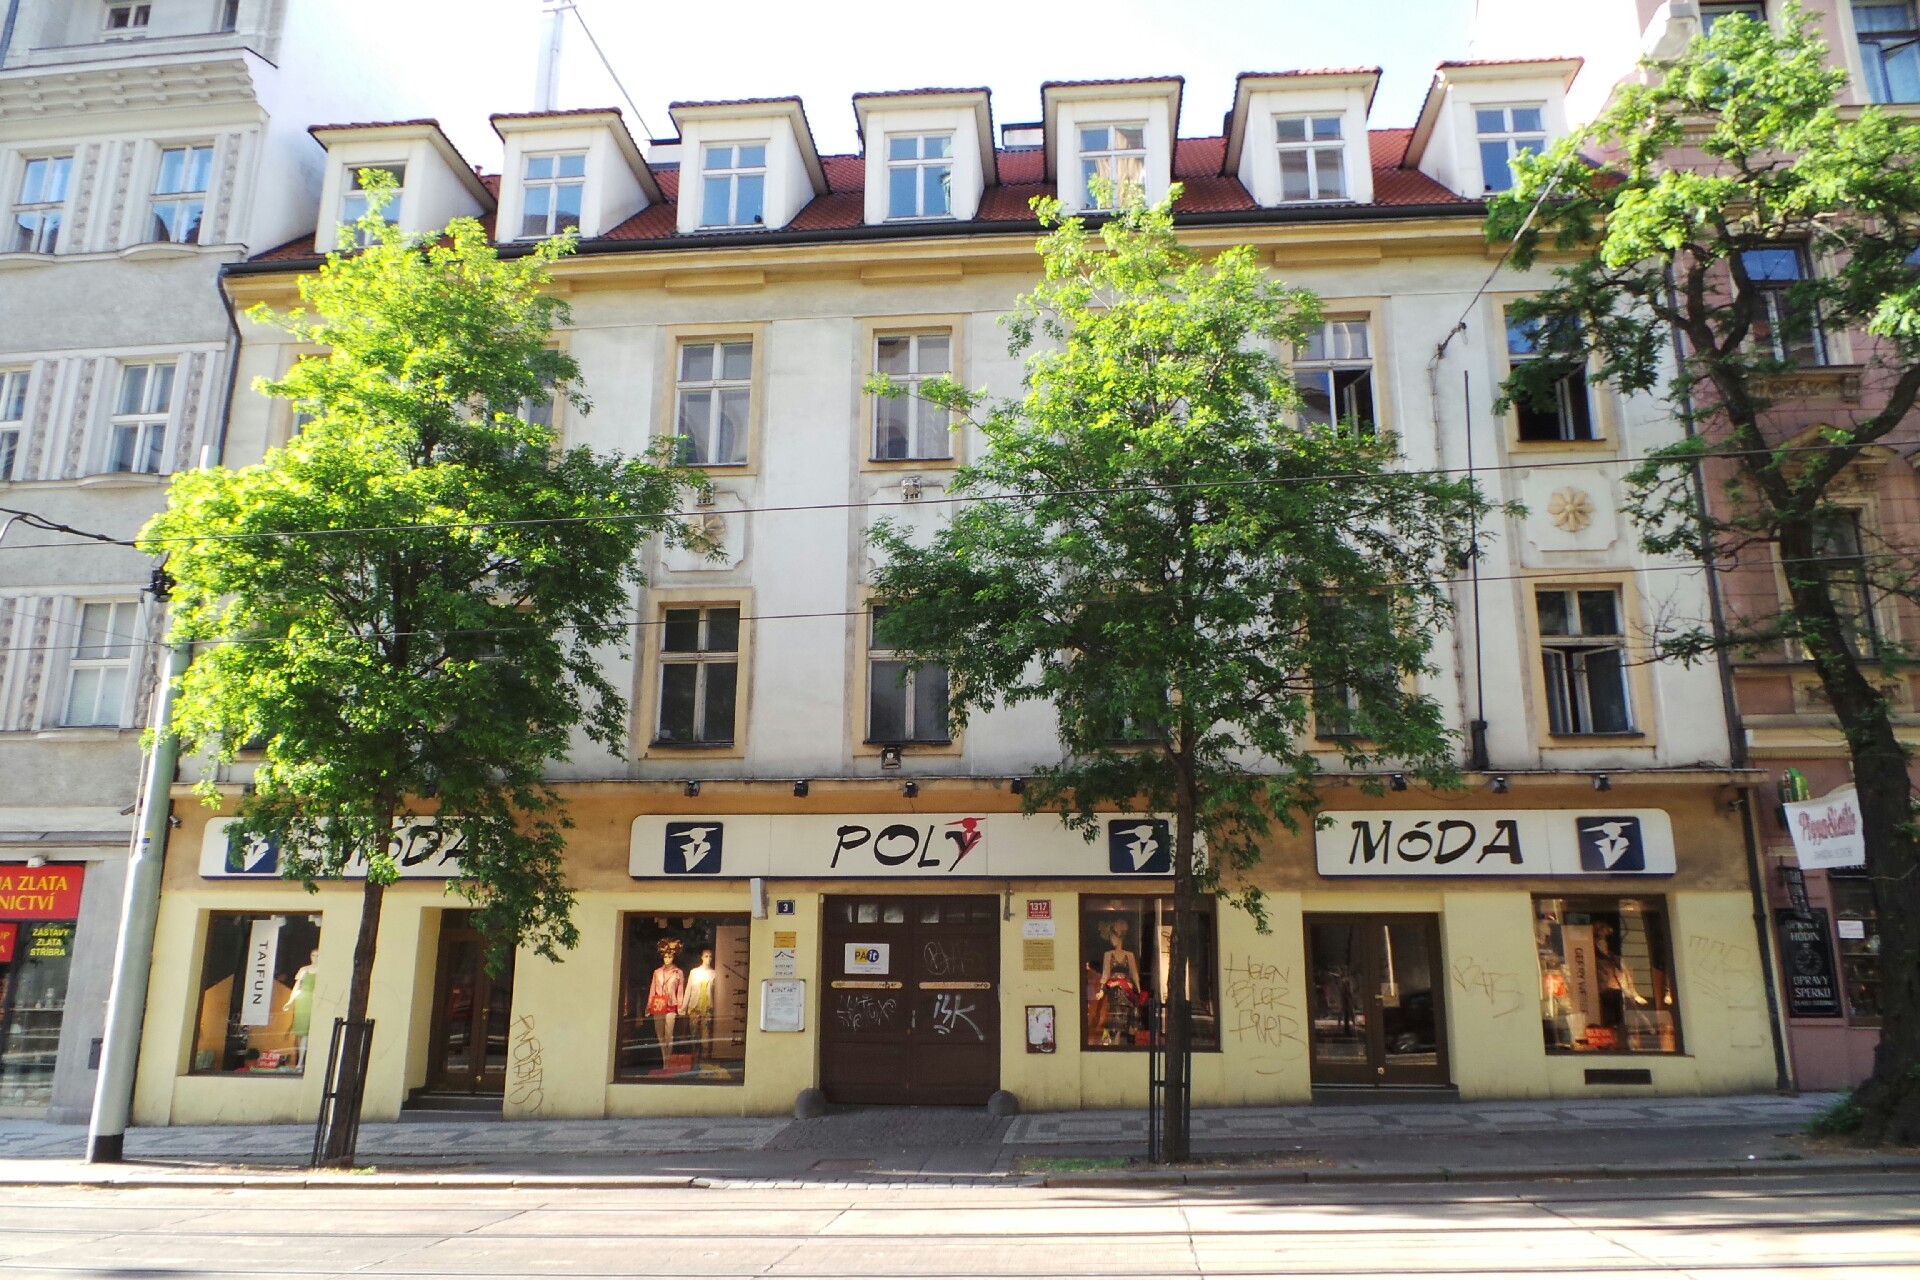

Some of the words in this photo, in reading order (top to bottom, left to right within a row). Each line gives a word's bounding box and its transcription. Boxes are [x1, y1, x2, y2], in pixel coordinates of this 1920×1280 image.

[831, 820, 983, 872] POLY
[1349, 820, 1524, 865] MÓDA
[17, 875, 68, 891] ZLATA
[0, 892, 56, 911] NICTVÍ
[783, 903, 789, 912] 3
[1029, 902, 1047, 911] 1317
[36, 938, 62, 946] ZLATA
[252, 940, 269, 1005] TAIFUN
